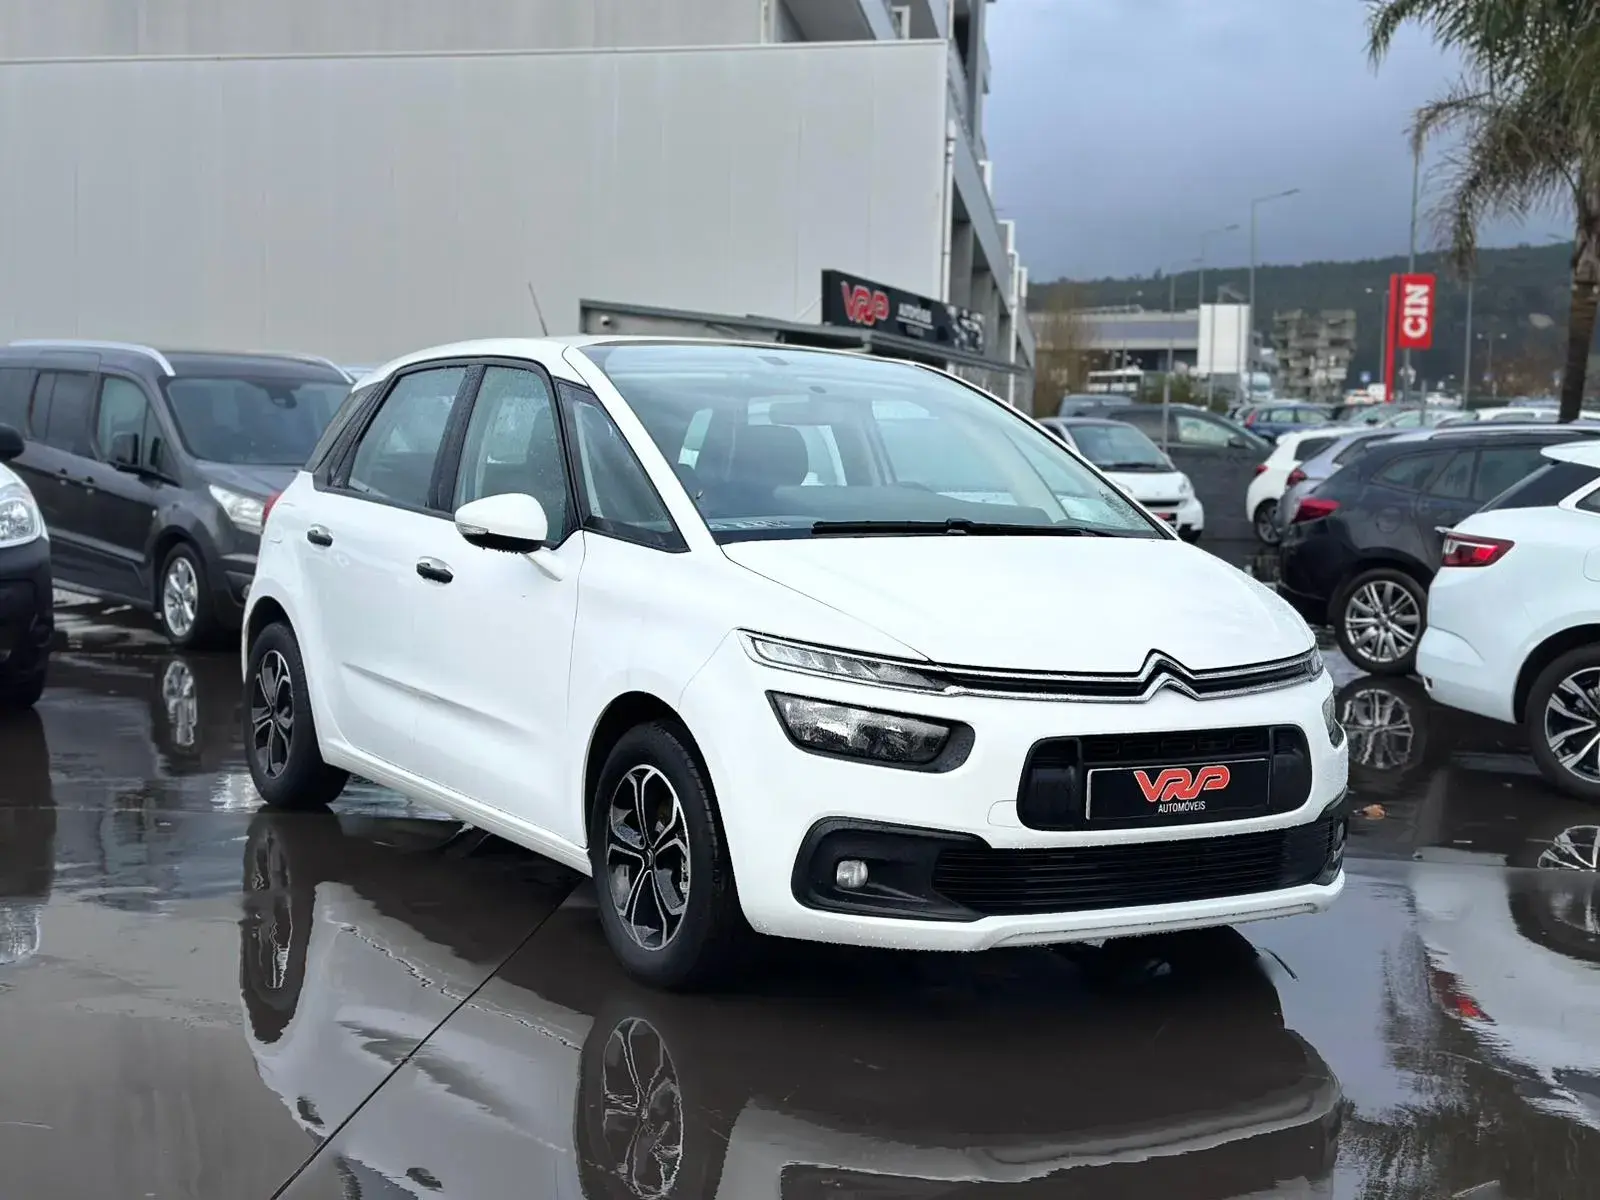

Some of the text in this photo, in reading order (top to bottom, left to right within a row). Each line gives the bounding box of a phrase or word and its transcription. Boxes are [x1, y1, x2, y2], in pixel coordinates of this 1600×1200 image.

[1403, 283, 1430, 338] CIN
[1133, 765, 1230, 802] VRP
[1158, 801, 1206, 813] AUTOMÓVEIS
